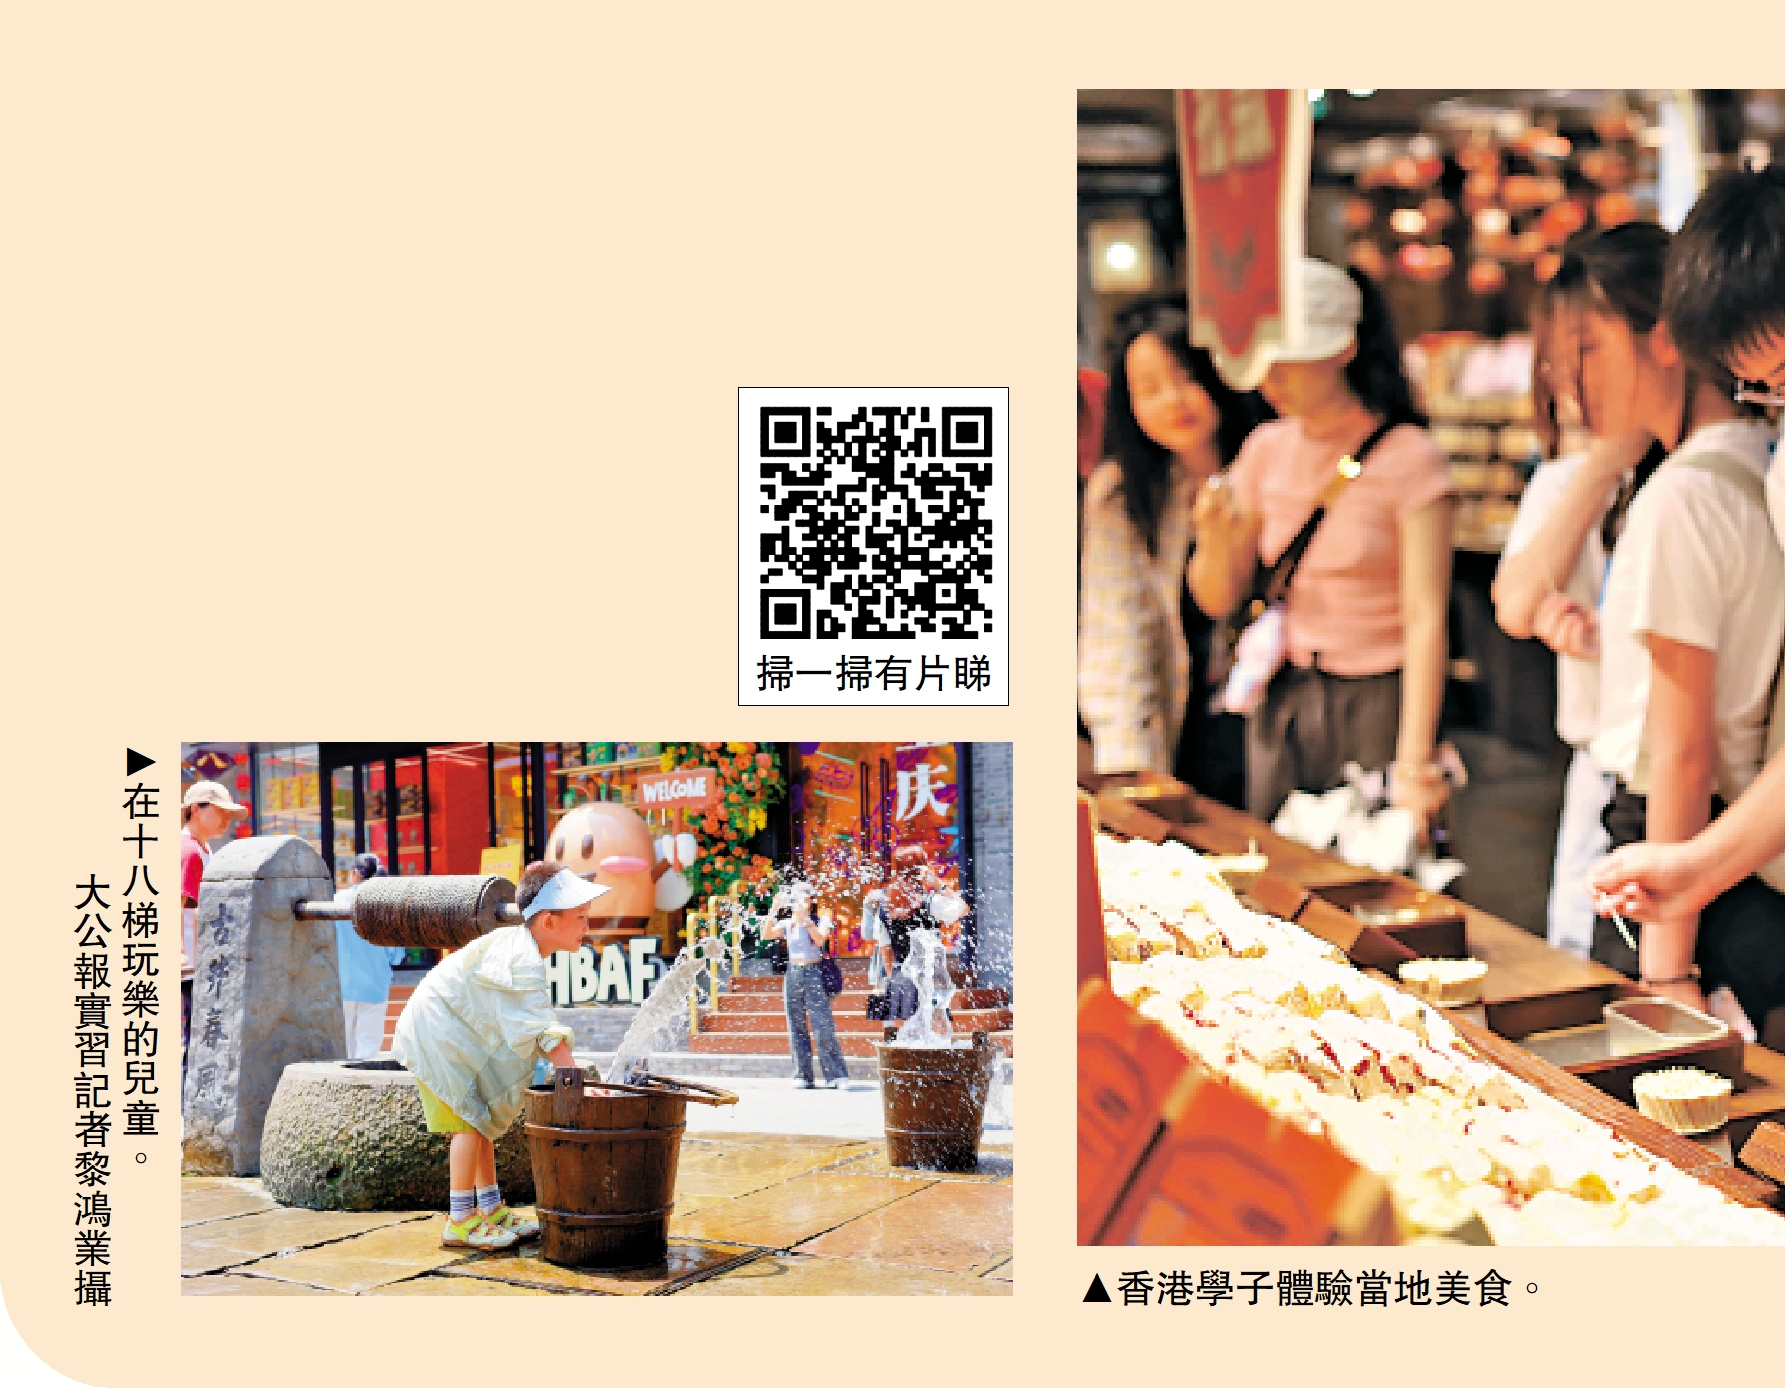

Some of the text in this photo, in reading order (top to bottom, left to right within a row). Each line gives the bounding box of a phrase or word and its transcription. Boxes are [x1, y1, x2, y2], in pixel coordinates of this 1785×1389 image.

[642, 776, 708, 804] WELCOME
[896, 742, 949, 821] 庆
[545, 936, 660, 1006] HBAF
